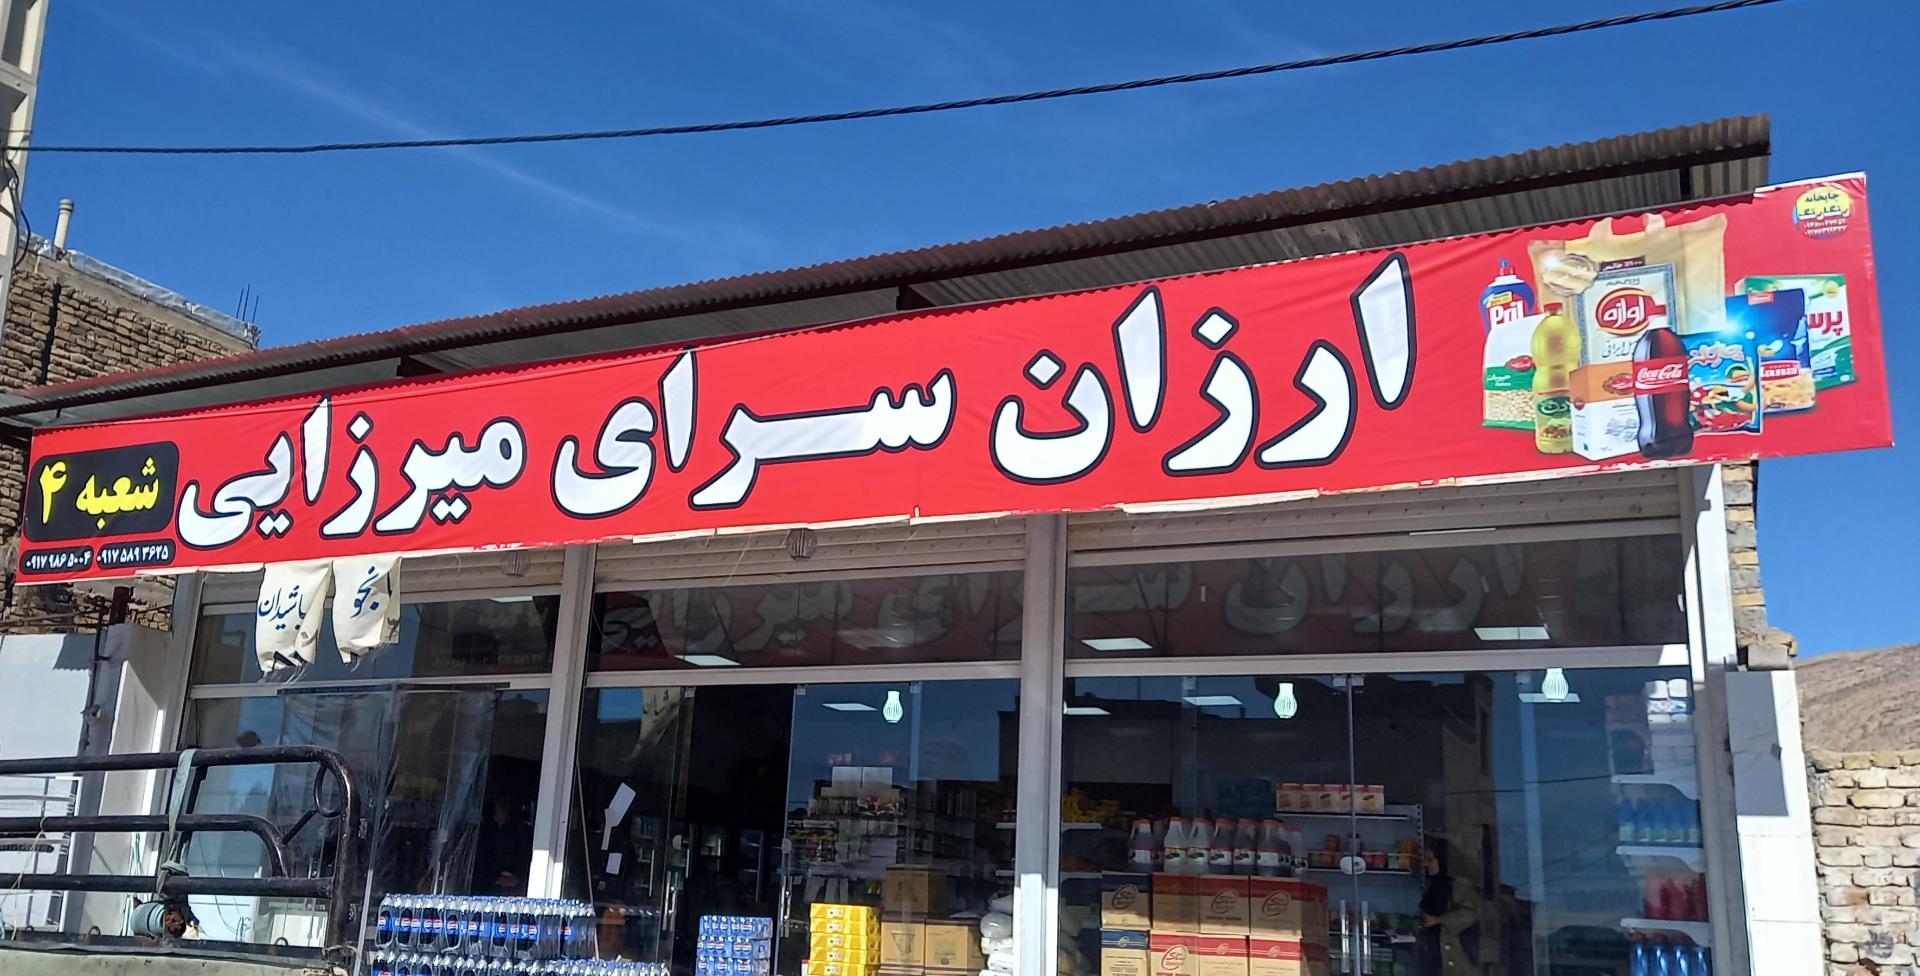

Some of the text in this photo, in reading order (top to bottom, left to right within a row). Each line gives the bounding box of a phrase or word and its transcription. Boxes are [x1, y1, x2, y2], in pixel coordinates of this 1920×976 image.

[39, 456, 159, 530] شعبه ۴
[175, 252, 1417, 550] ارزان سرای میرزایی
